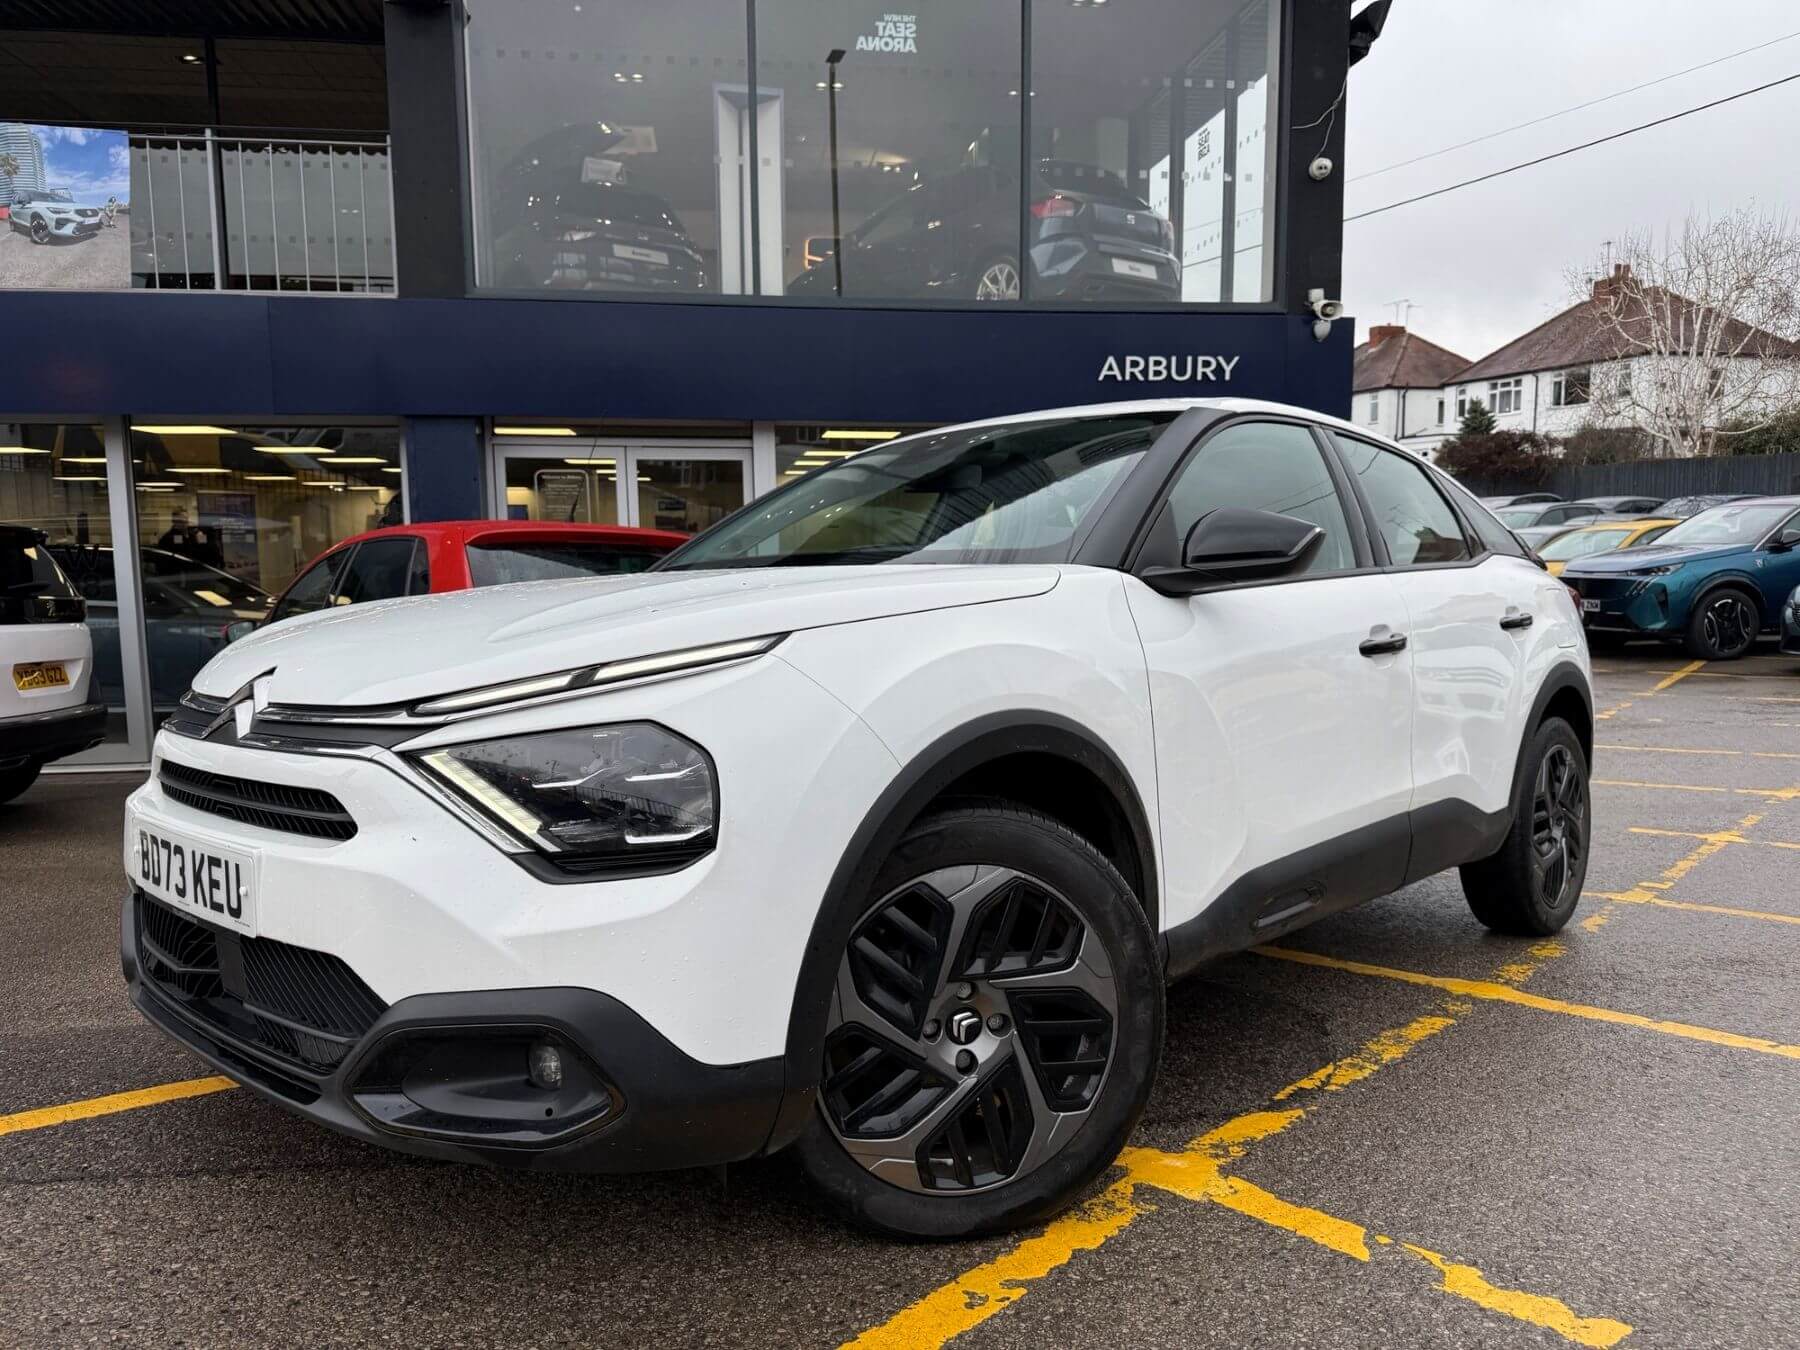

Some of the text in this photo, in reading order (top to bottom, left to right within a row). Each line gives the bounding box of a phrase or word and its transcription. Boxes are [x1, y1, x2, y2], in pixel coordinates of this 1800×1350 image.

[1098, 355, 1240, 381] ARBURY
[139, 829, 242, 919] BD73 KEU
